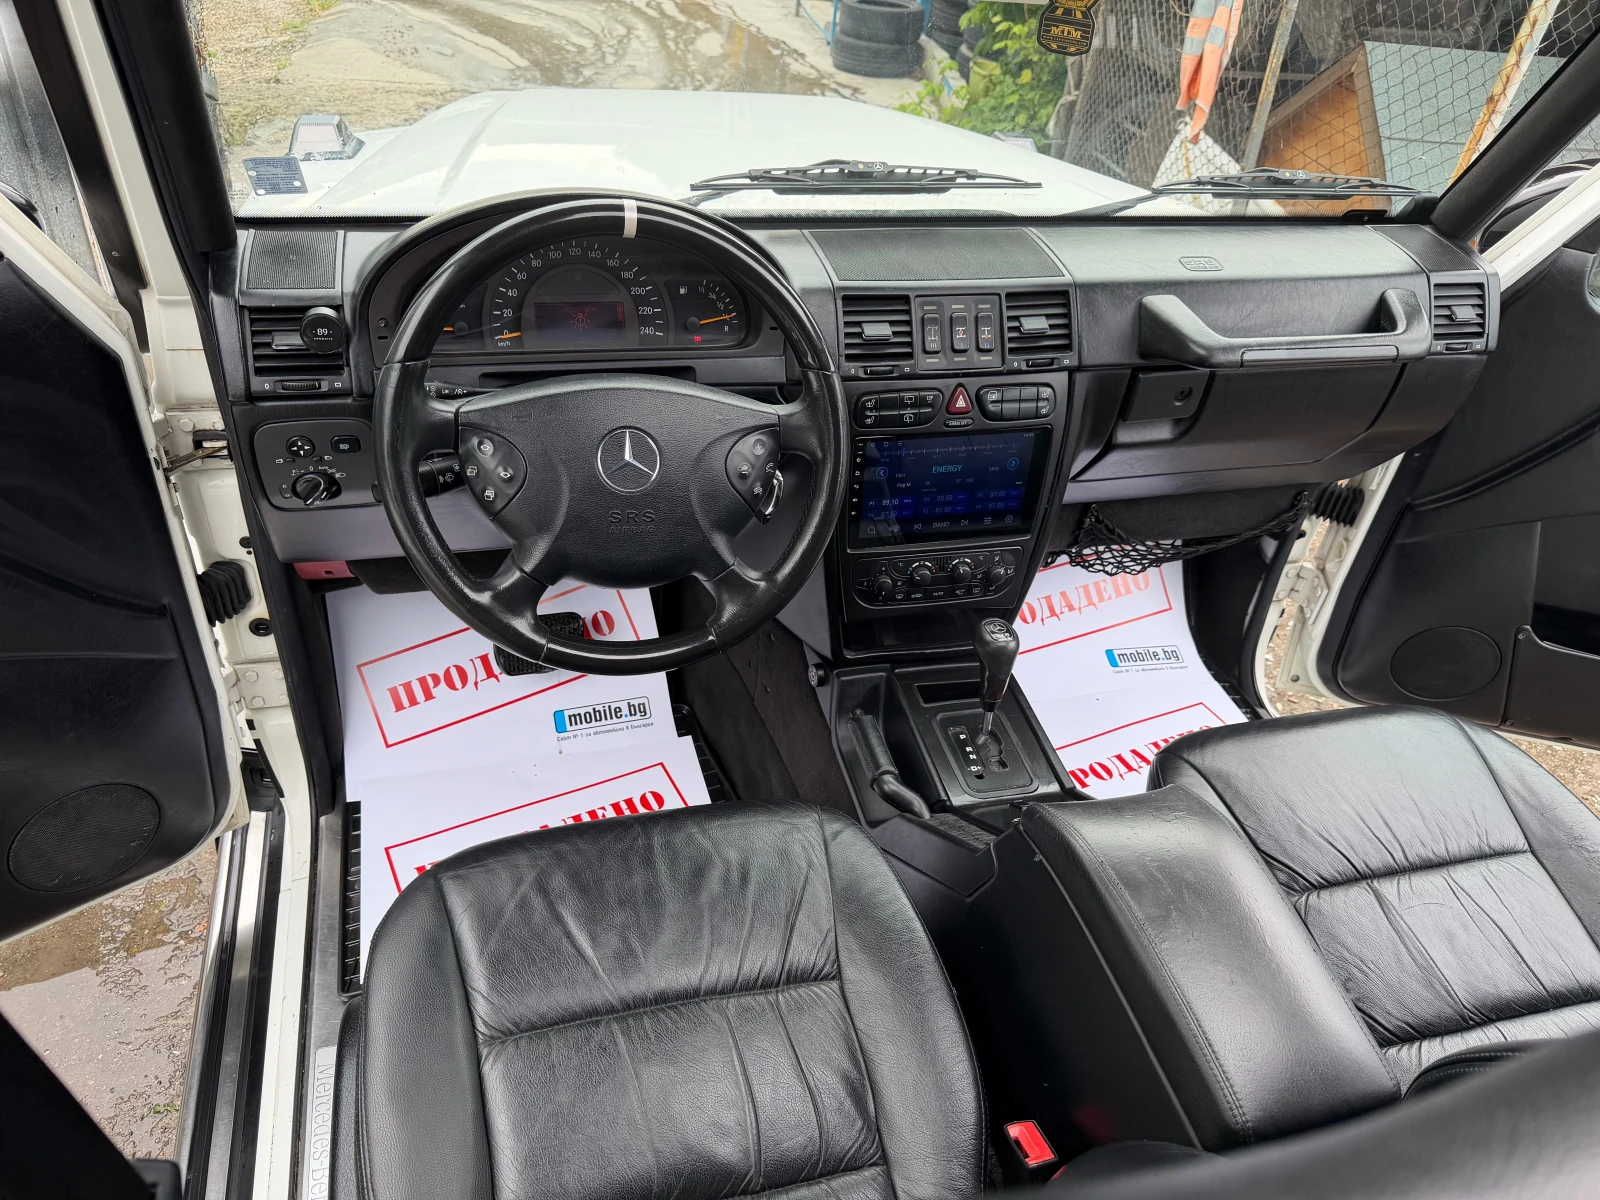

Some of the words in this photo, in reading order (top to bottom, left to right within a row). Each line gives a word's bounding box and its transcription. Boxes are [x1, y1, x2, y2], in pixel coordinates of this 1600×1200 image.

[1050, 26, 1082, 39] MTM
[517, 272, 527, 280] 60
[932, 464, 962, 473] ENERGY
[608, 510, 654, 522] SRS
[1018, 572, 1150, 626] ОДАДЕНО
[387, 610, 615, 712] ПРОДО
[1117, 648, 1180, 664] mobile.bg
[568, 702, 648, 726] mobile.bg
